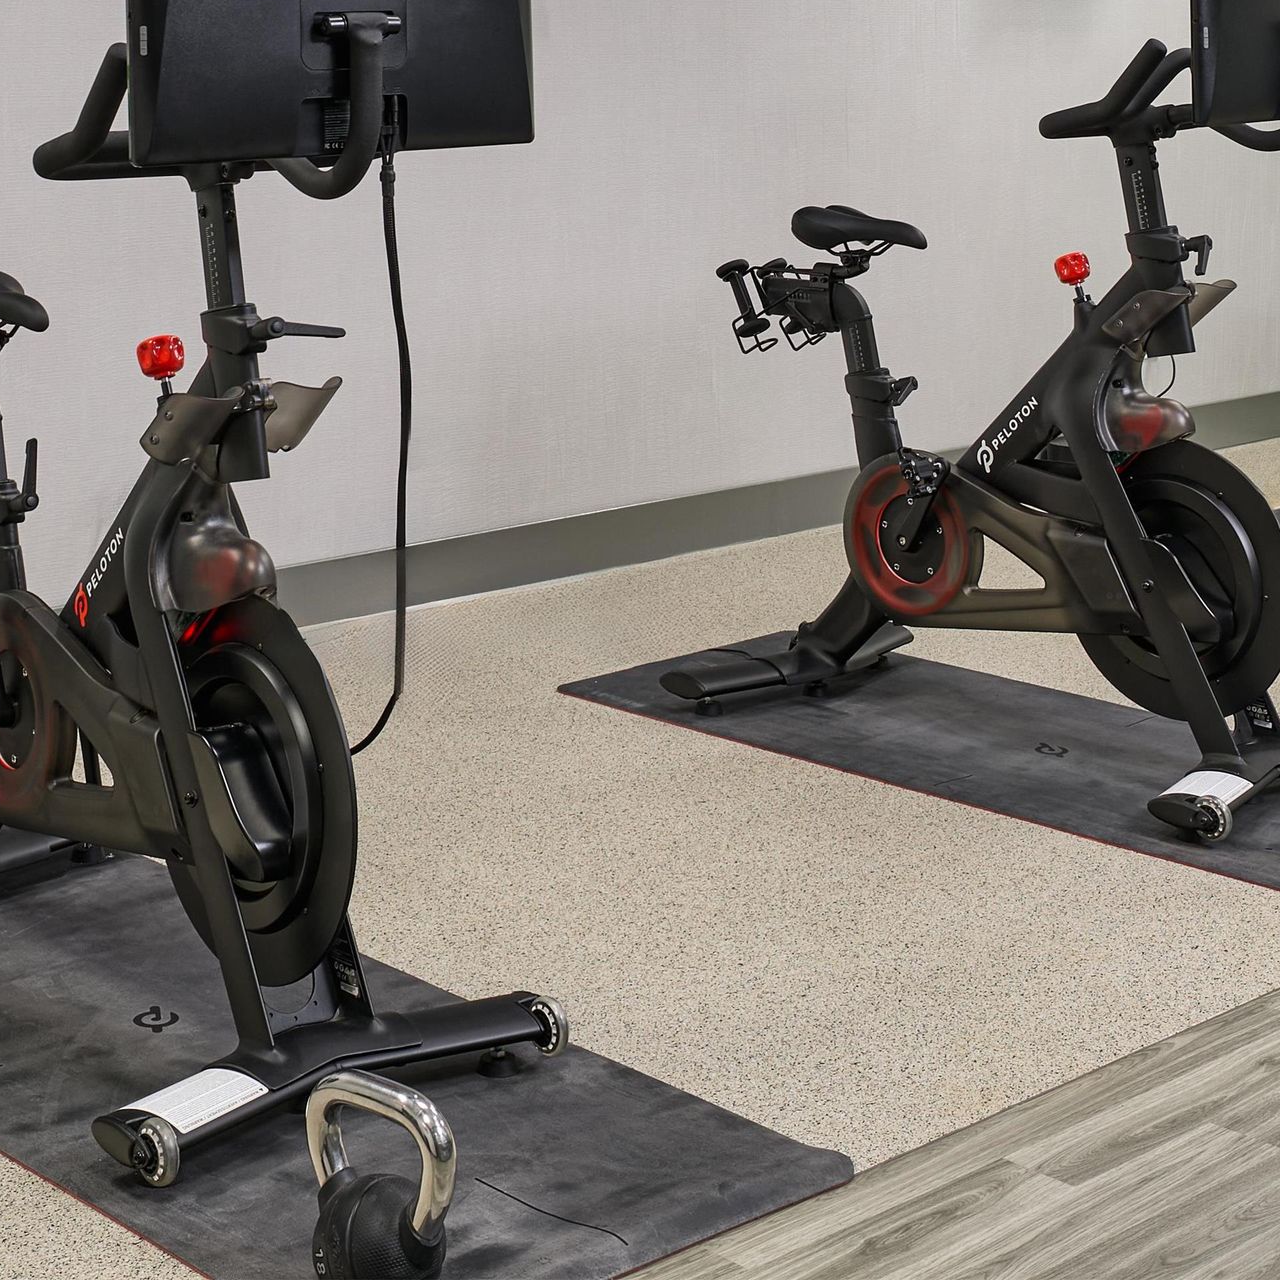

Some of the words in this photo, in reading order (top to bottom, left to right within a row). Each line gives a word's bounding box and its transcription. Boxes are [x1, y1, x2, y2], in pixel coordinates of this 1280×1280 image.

[992, 397, 1038, 450] PELOTON
[86, 528, 124, 597] PELOTON
[315, 1248, 326, 1275] 18
